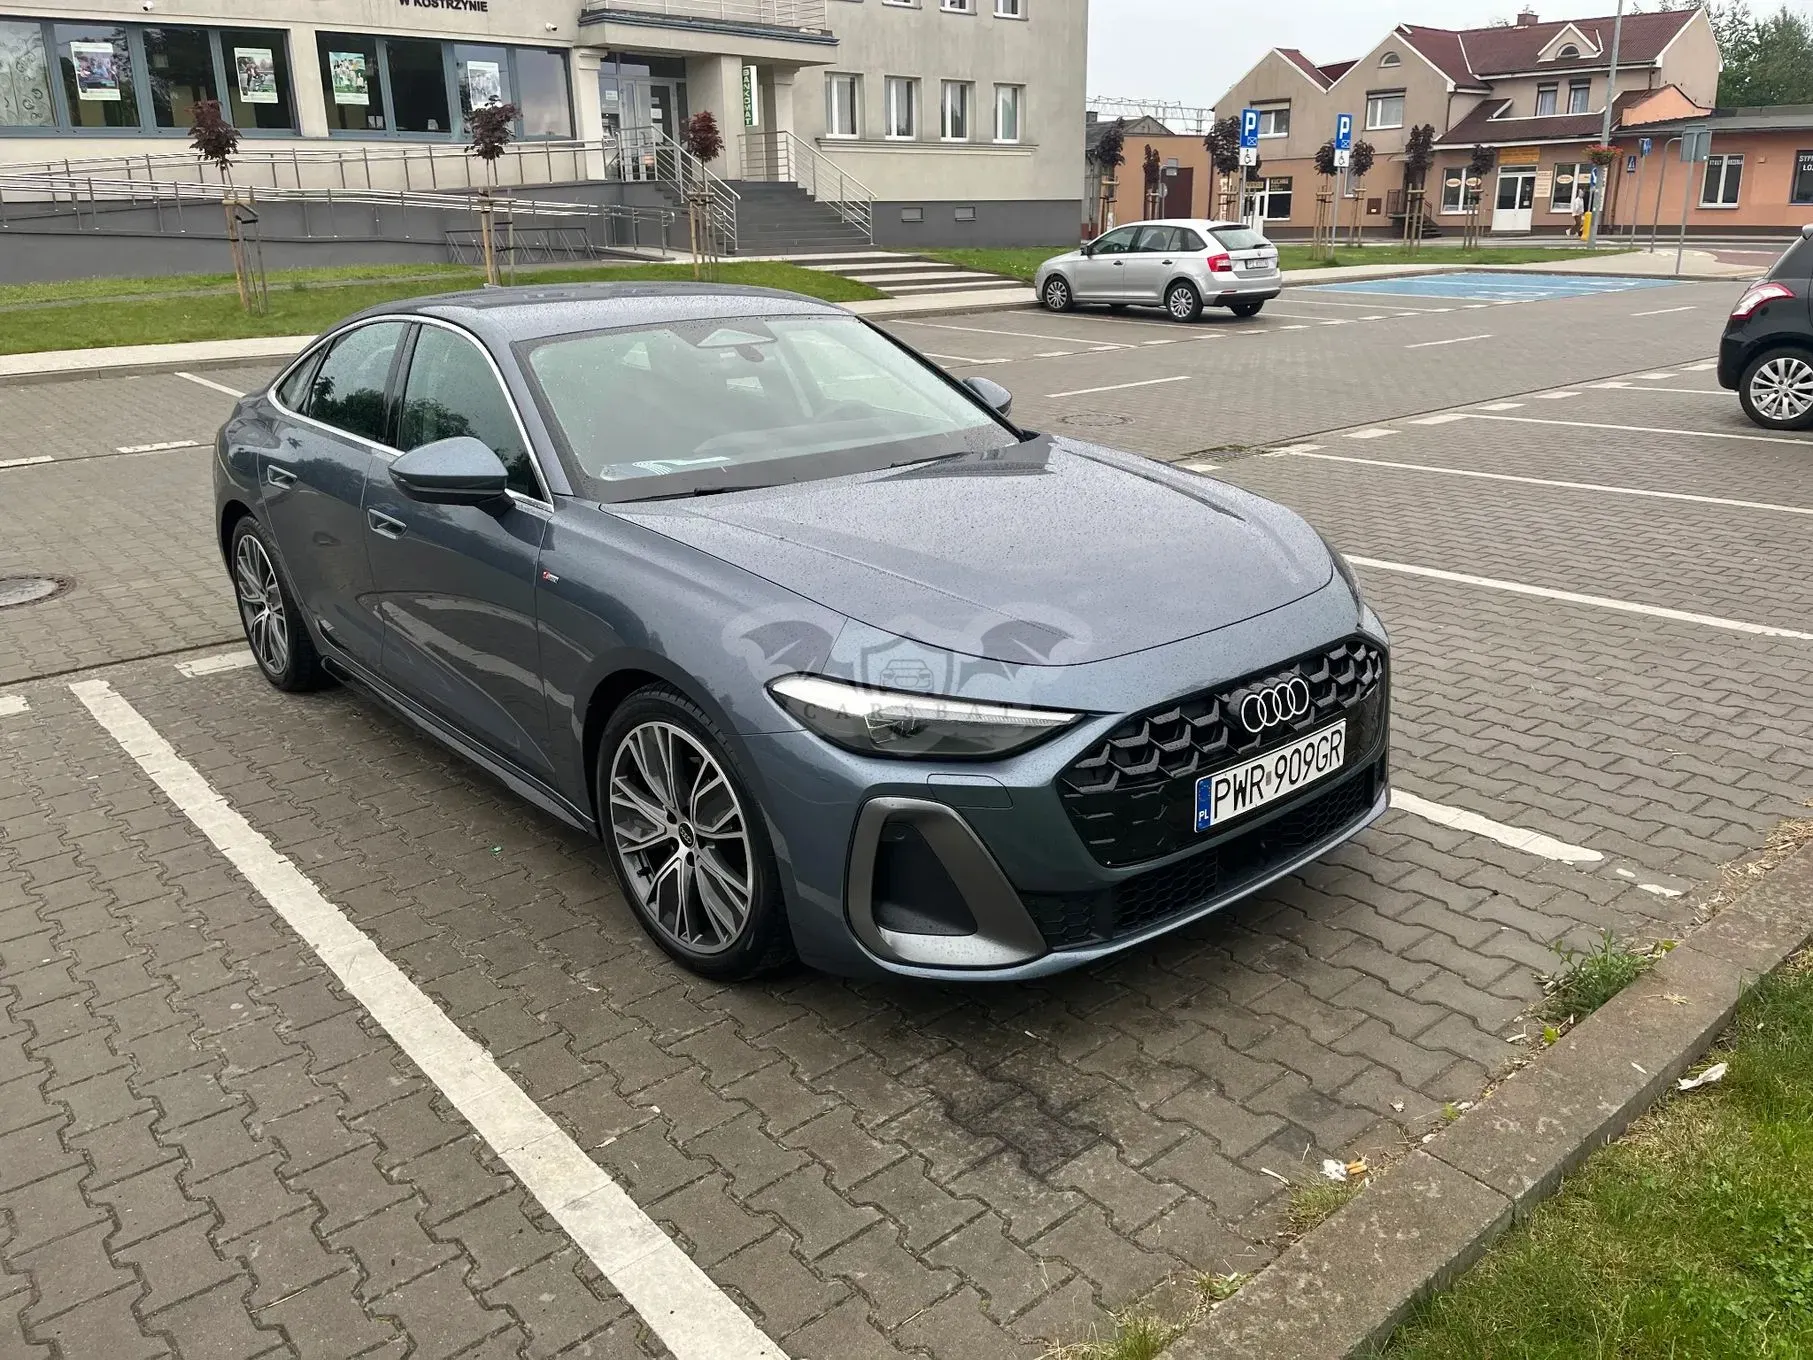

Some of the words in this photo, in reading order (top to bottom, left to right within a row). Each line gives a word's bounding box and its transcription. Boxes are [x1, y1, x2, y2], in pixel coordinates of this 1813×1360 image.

[414, 0, 488, 12] KOSTRZYNIE
[743, 69, 751, 125] BANKOMAT
[1245, 112, 1257, 136] P
[1339, 116, 1350, 140] P
[1214, 764, 1266, 819] PWR
[1273, 729, 1343, 794] 909GR
[1198, 810, 1209, 822] PL
